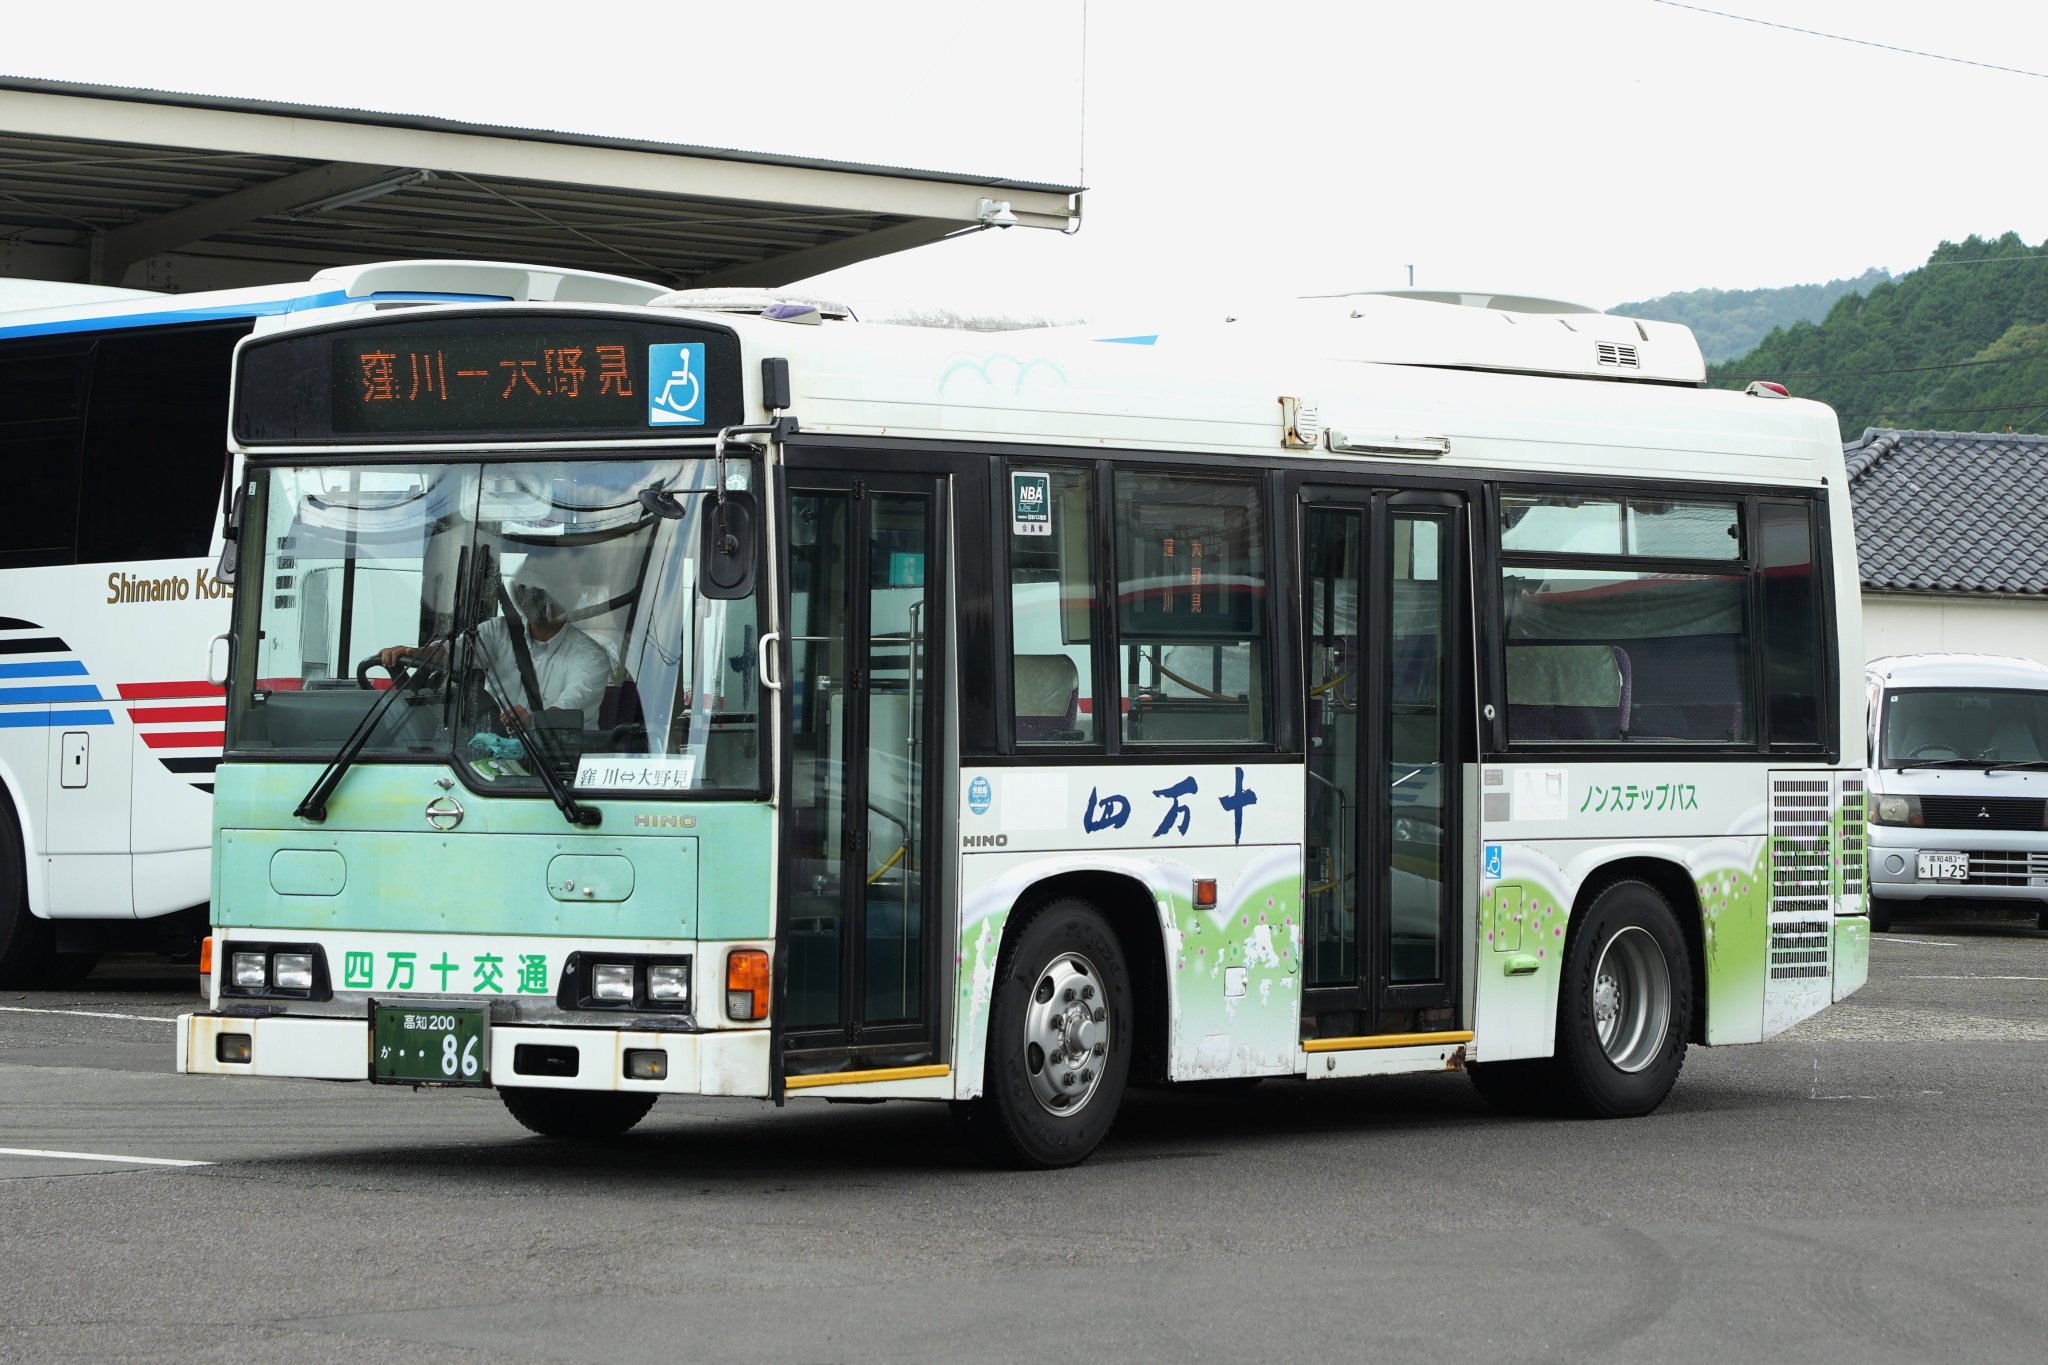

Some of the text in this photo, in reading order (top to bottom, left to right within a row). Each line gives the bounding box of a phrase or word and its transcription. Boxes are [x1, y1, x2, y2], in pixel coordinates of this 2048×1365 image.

[1020, 486, 1043, 500] NBA
[107, 572, 189, 604] Shimanto
[1083, 766, 1258, 848] 四万十
[1580, 783, 1699, 813] ノンステップバス
[633, 814, 697, 829] HINO
[963, 834, 1008, 848] HINO
[1930, 863, 1966, 878] 11-25
[344, 951, 549, 994] 四万十交通
